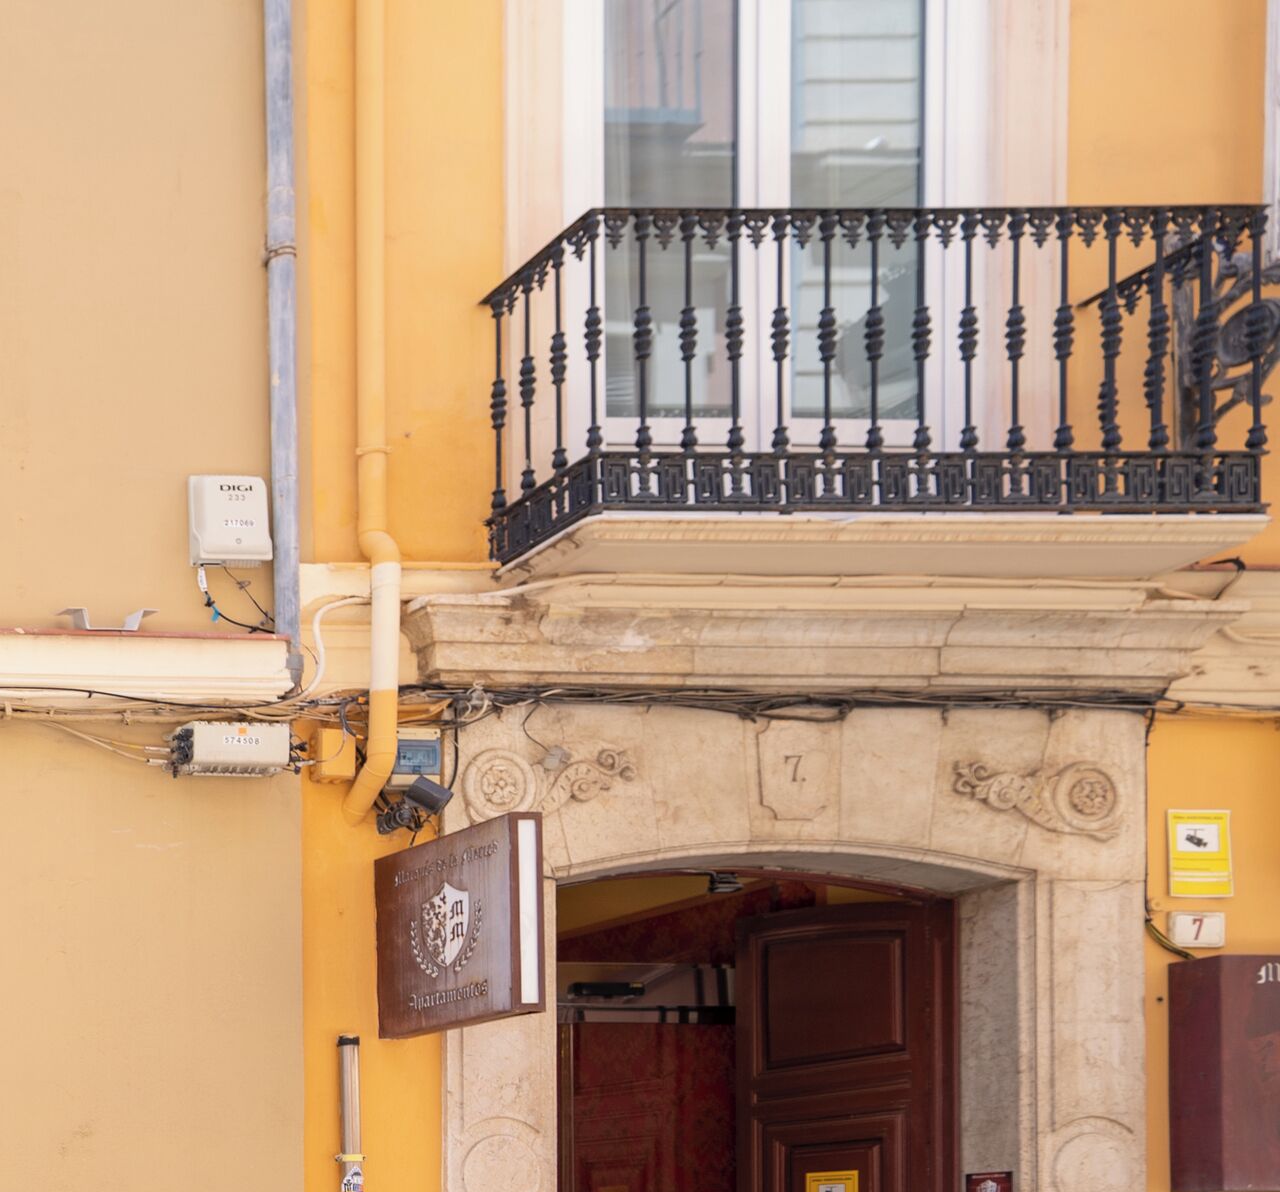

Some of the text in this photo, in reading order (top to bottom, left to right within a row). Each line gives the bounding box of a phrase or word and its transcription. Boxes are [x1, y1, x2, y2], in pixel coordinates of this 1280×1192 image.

[219, 484, 253, 492] DIGI
[1192, 918, 1204, 941] 7
[409, 979, 488, 1011] Apartamentos
